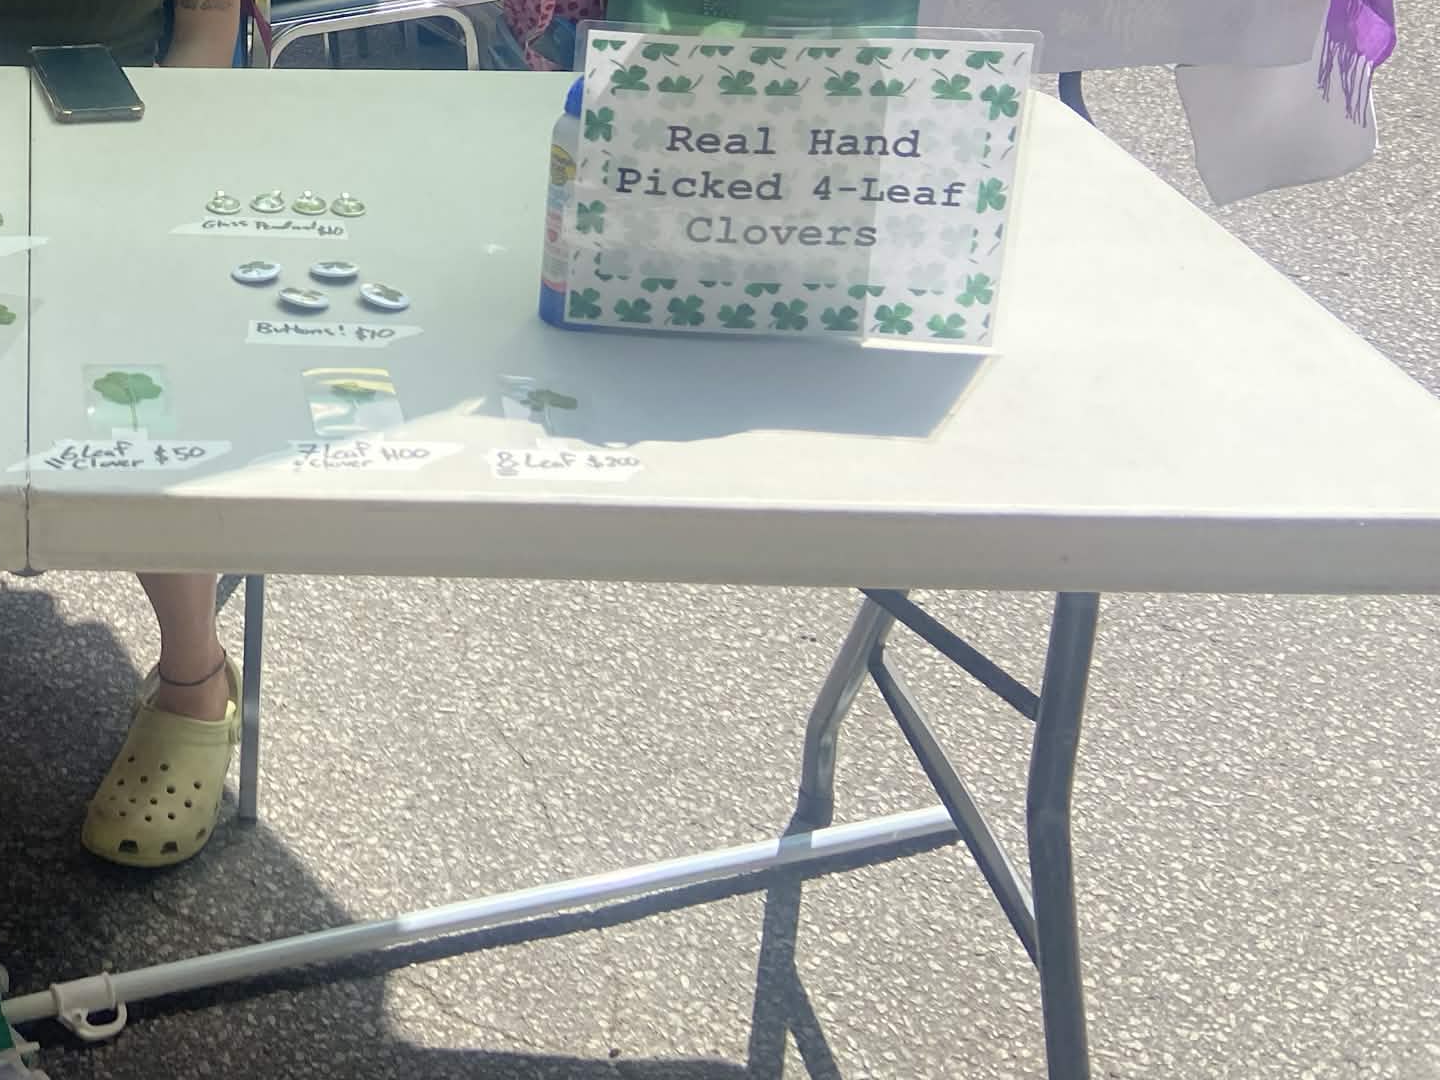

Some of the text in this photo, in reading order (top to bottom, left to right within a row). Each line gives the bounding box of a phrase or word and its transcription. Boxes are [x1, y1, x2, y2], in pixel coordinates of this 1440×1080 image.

[665, 125, 921, 159] Real Hand
[614, 167, 966, 208] Picked 4-Leaf
[686, 216, 879, 247] Clovers
[355, 326, 396, 341] $10
[60, 445, 78, 461] 6
[153, 445, 206, 465] $50
[296, 443, 321, 461] 7
[496, 451, 520, 469] 8
